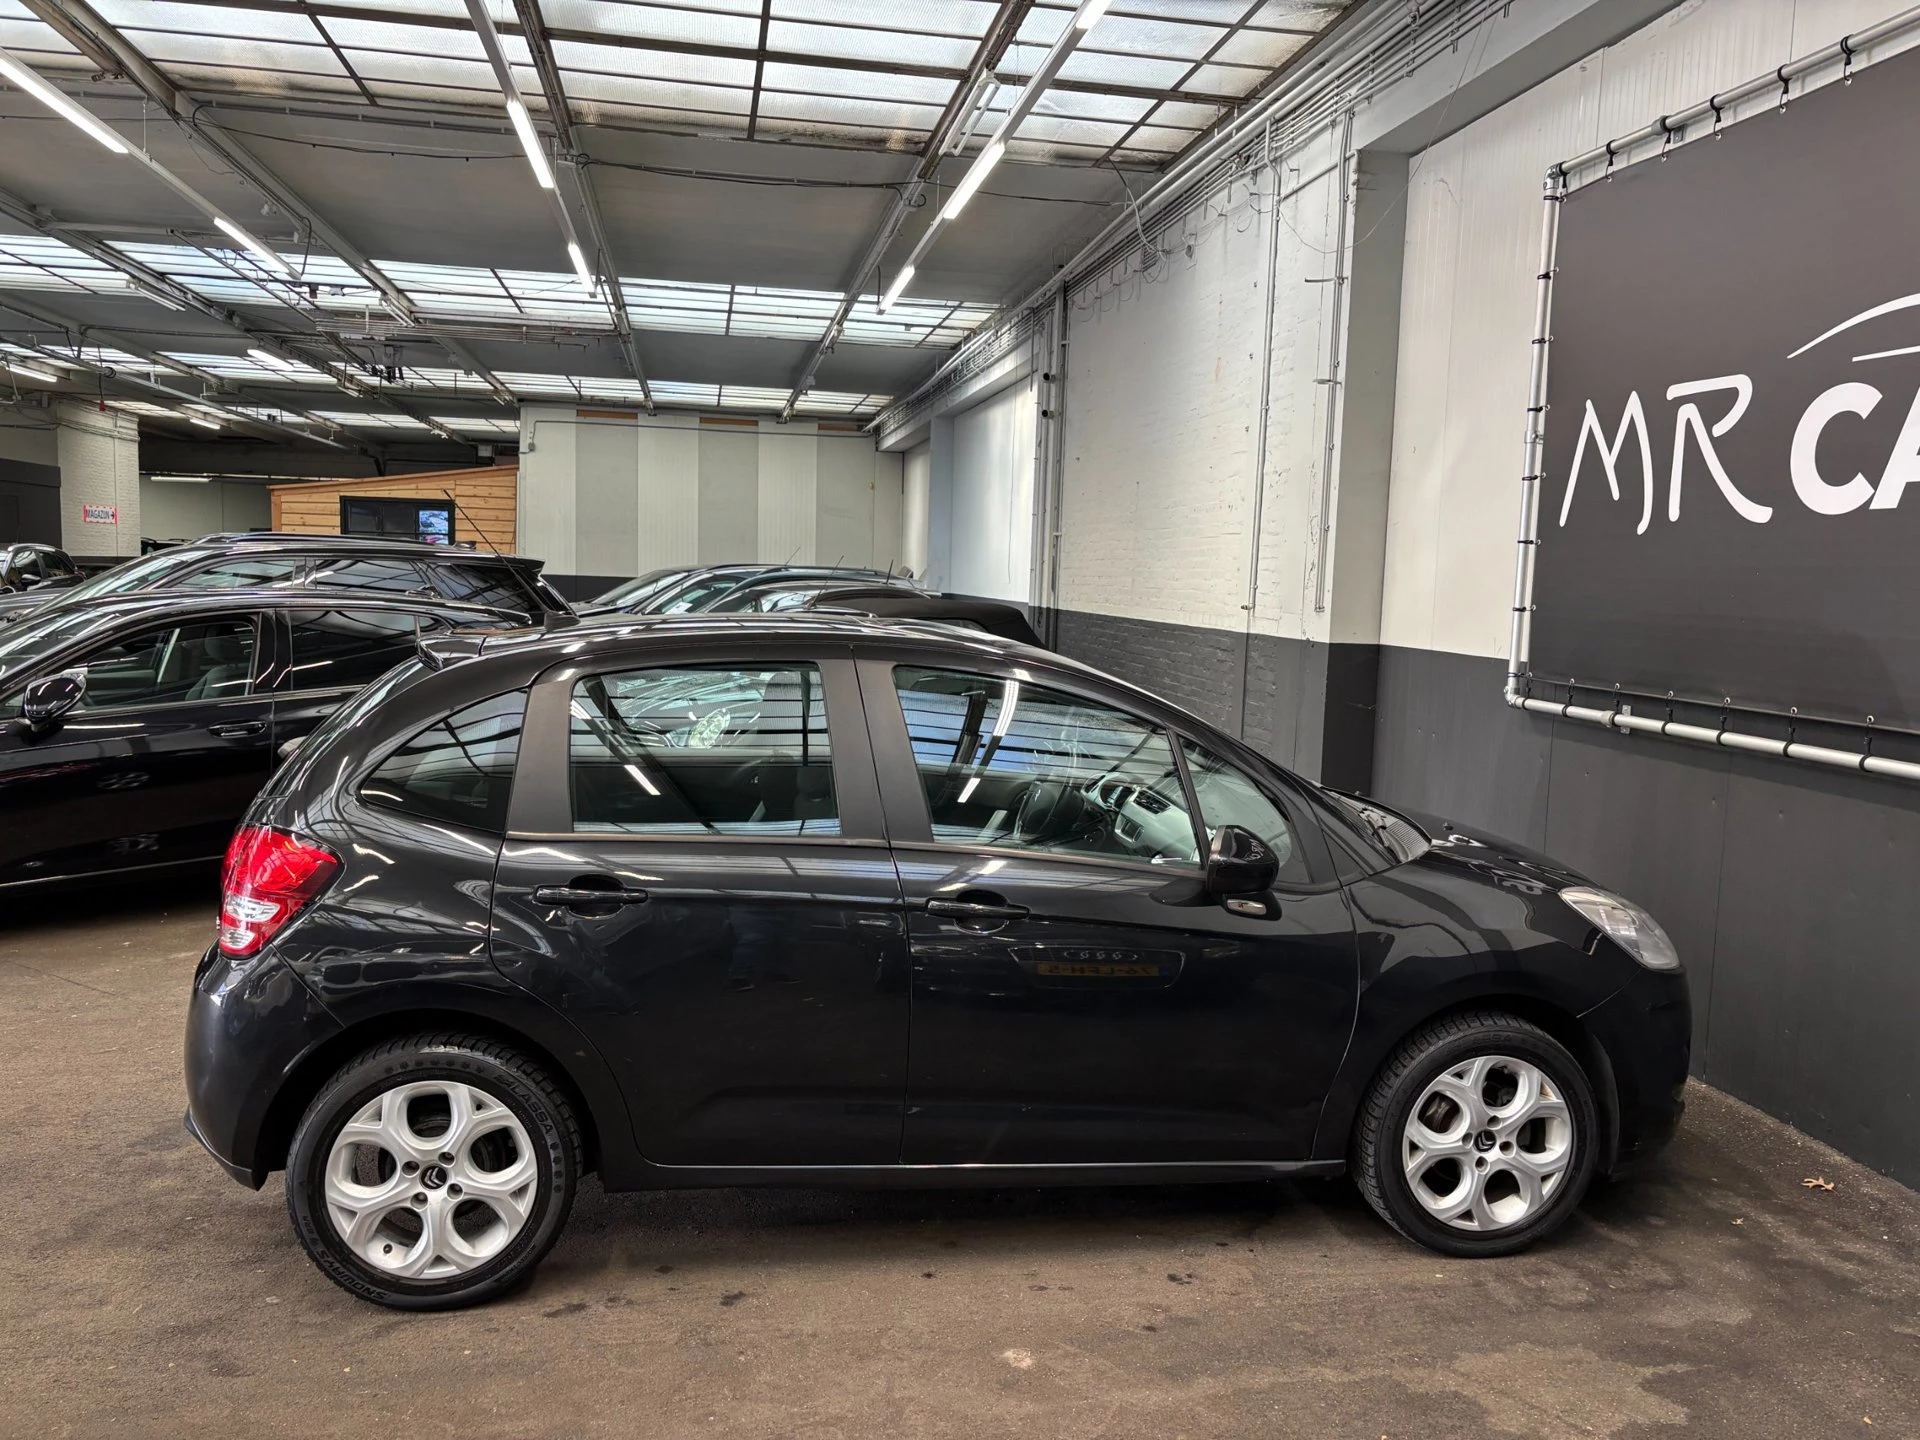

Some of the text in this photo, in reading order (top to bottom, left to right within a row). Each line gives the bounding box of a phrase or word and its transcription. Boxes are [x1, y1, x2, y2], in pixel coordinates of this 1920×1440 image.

[1559, 374, 1773, 535] MR
[510, 1084, 555, 1134] LASSA
[316, 1249, 388, 1300] SNOWAYS
